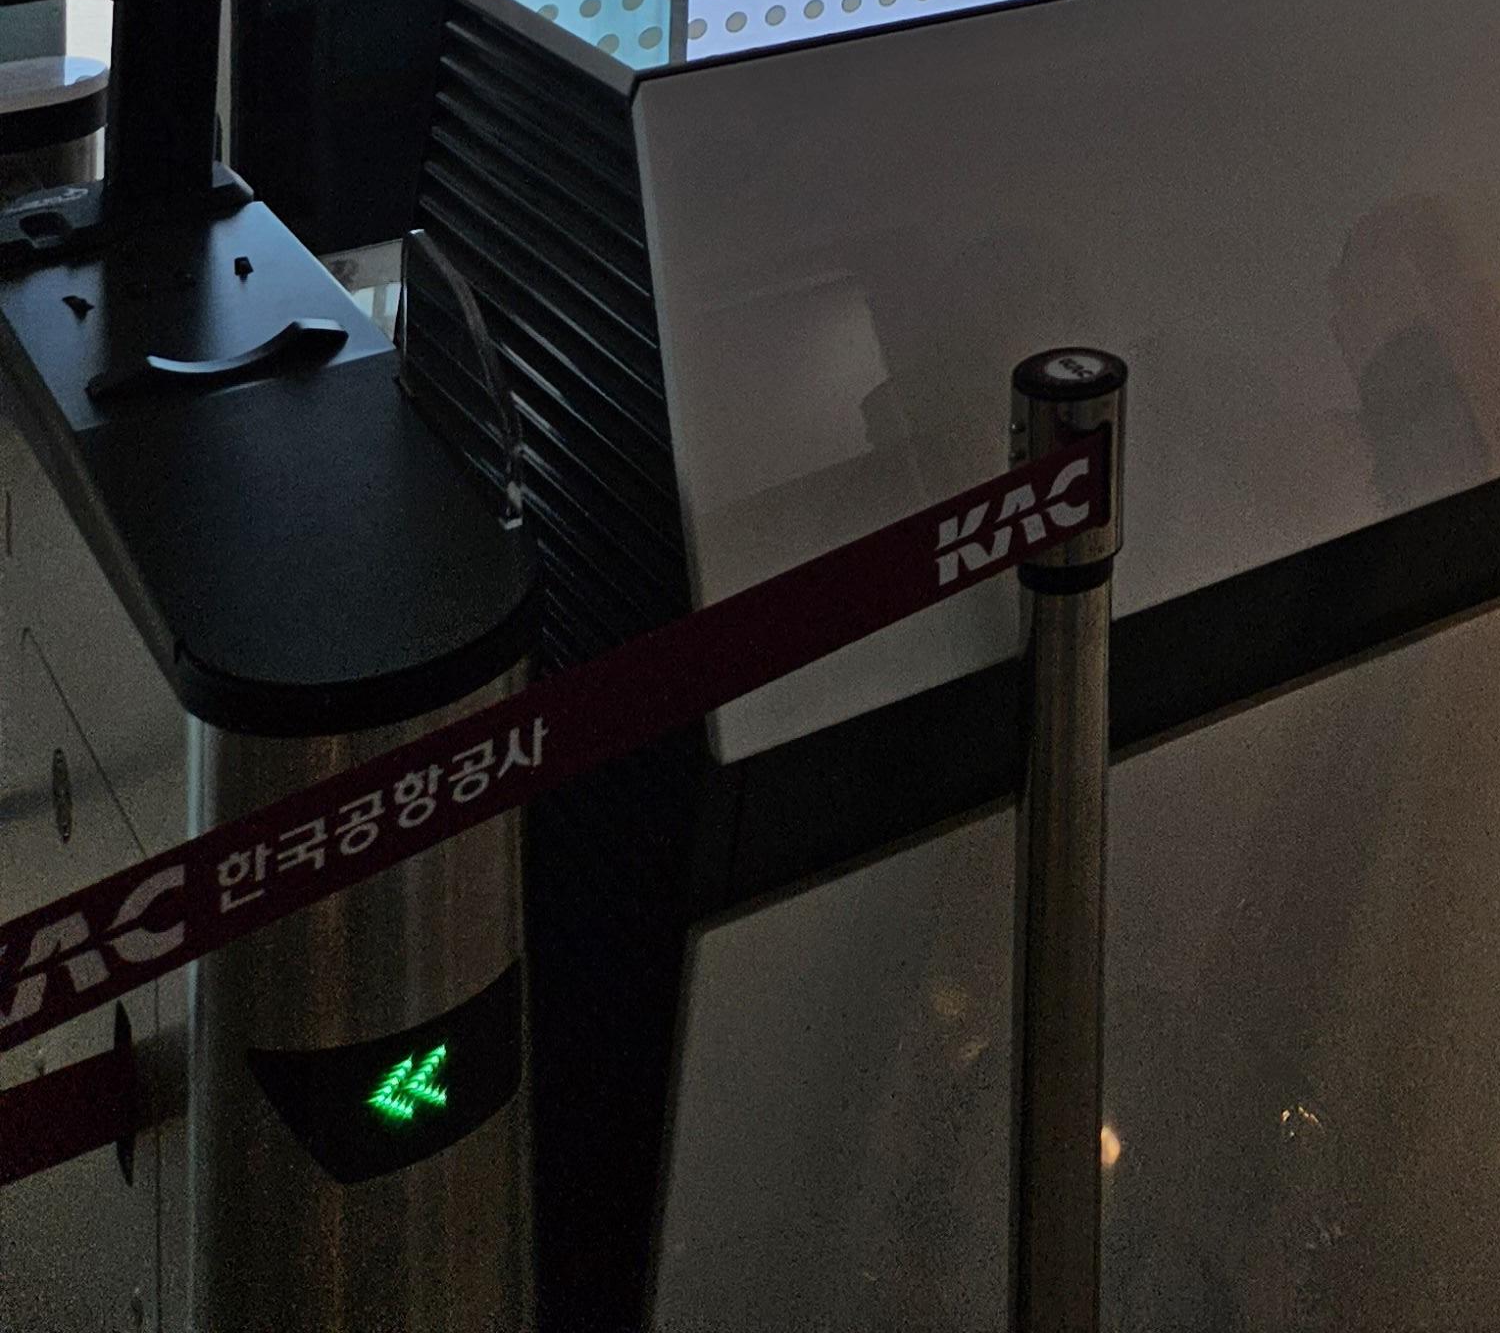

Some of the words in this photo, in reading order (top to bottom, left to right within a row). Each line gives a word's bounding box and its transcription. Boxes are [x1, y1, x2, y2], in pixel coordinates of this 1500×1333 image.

[935, 457, 1090, 586] KAC
[0, 864, 185, 1030] AC
[217, 717, 549, 913] 한국공항공사
